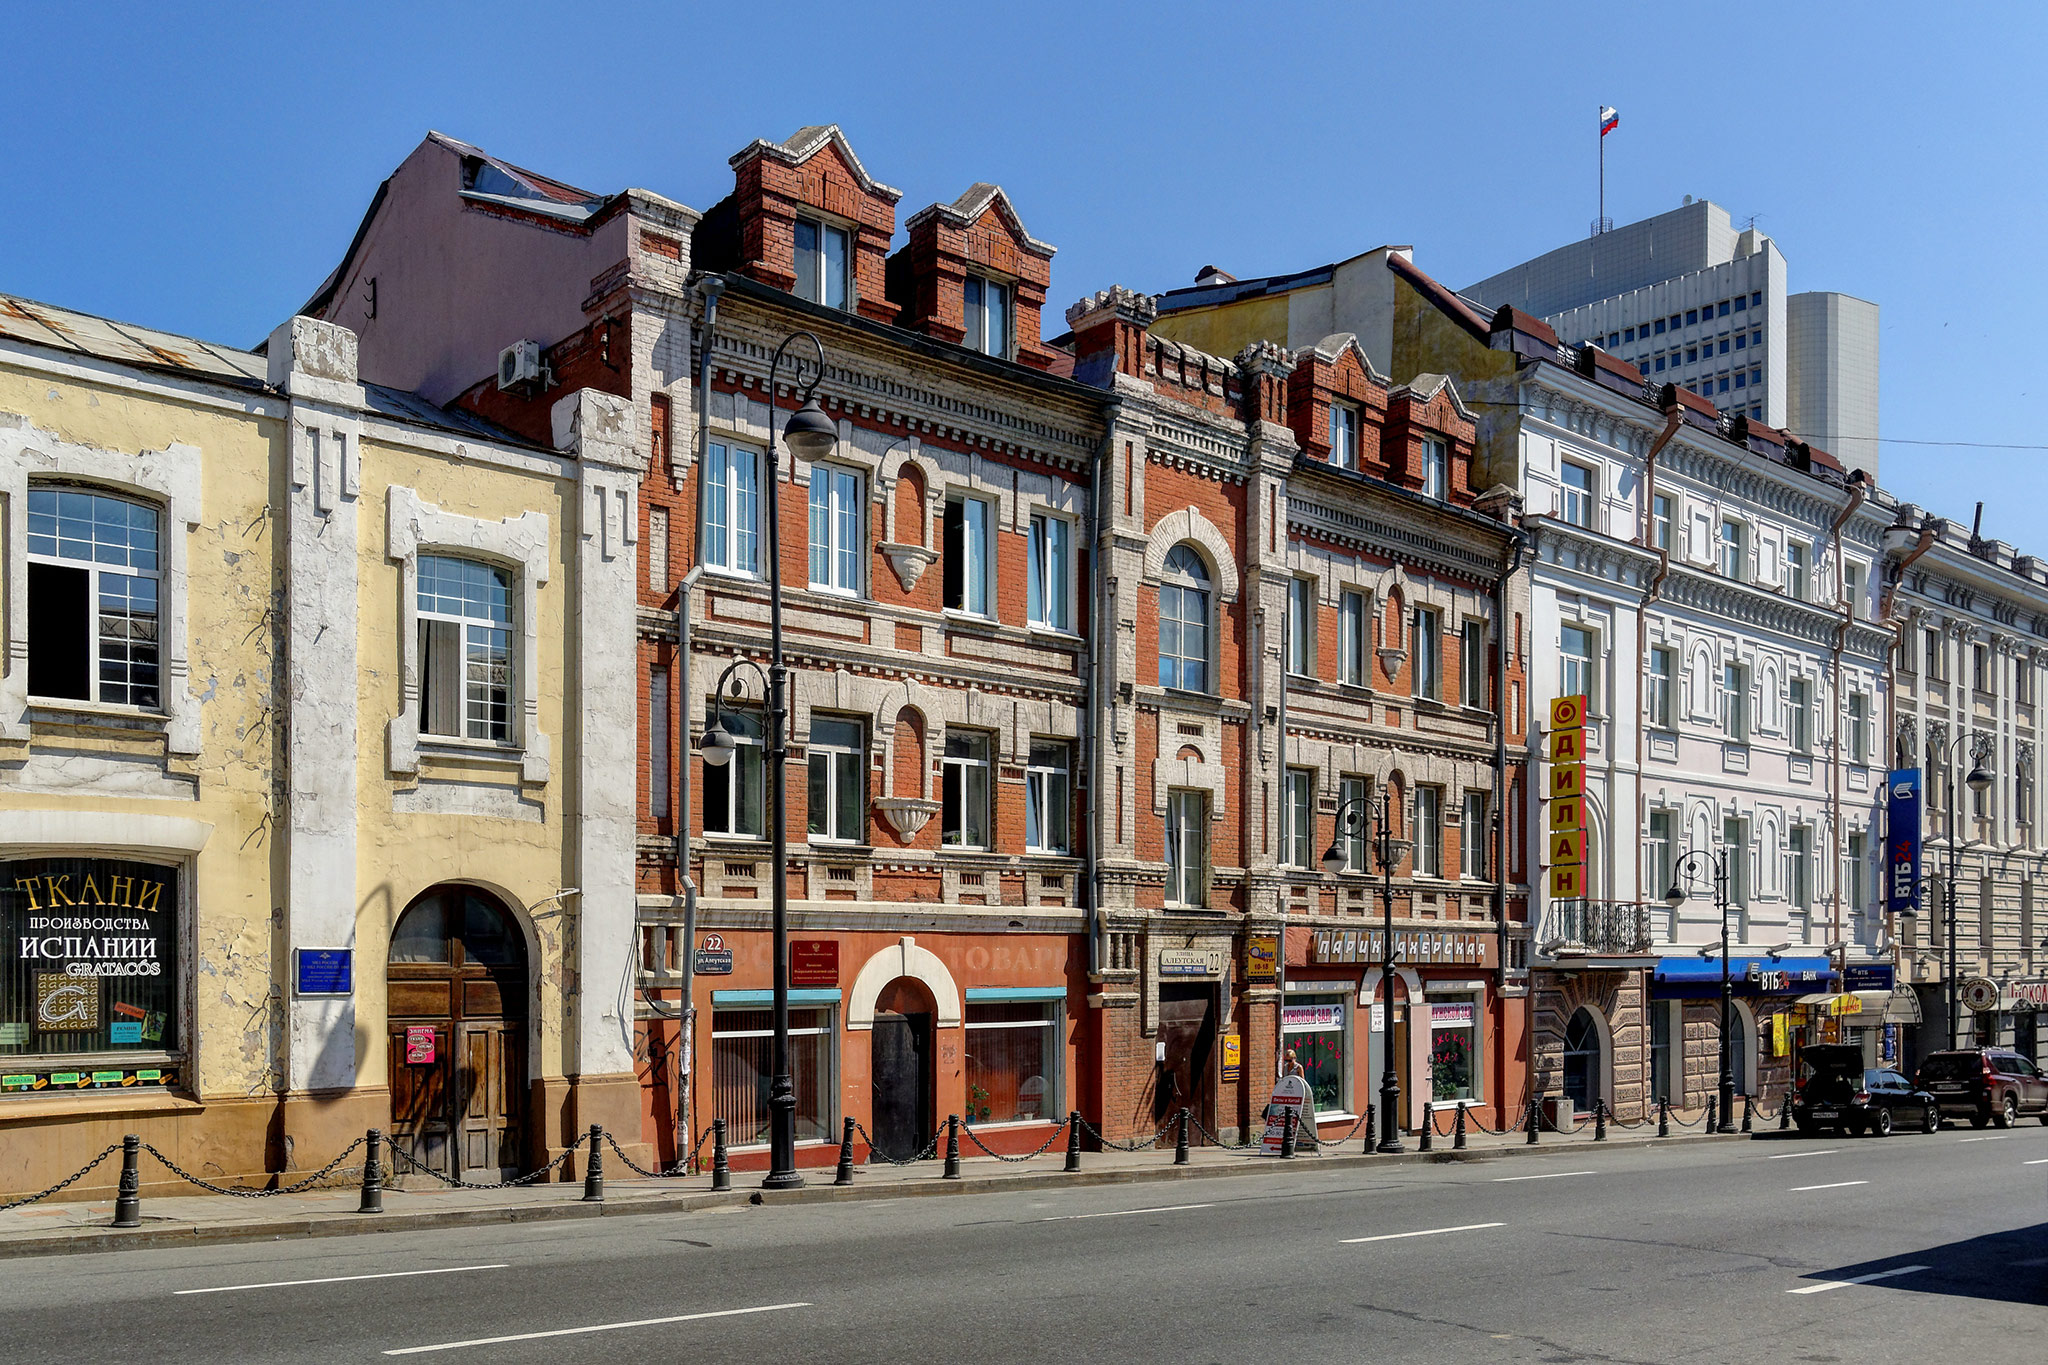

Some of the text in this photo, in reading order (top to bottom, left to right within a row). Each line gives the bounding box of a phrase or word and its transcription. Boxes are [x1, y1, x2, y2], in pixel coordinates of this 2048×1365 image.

[1555, 735, 1574, 891] ДИЛАН
[1895, 840, 1911, 898] ВТБ24
[15, 873, 165, 913] ТКАНИ
[29, 917, 150, 931] ПРОИЗВОДСТВА
[19, 936, 157, 959] ИСПАНИИ
[707, 937, 721, 951] 22
[1318, 940, 1486, 956] ПАРИКАХЕРСКАЯ
[65, 959, 161, 977] GRATACÓS
[1209, 953, 1219, 971] 22
[1762, 971, 1790, 991] ВТБ24
[1802, 970, 1817, 981] БАНК
